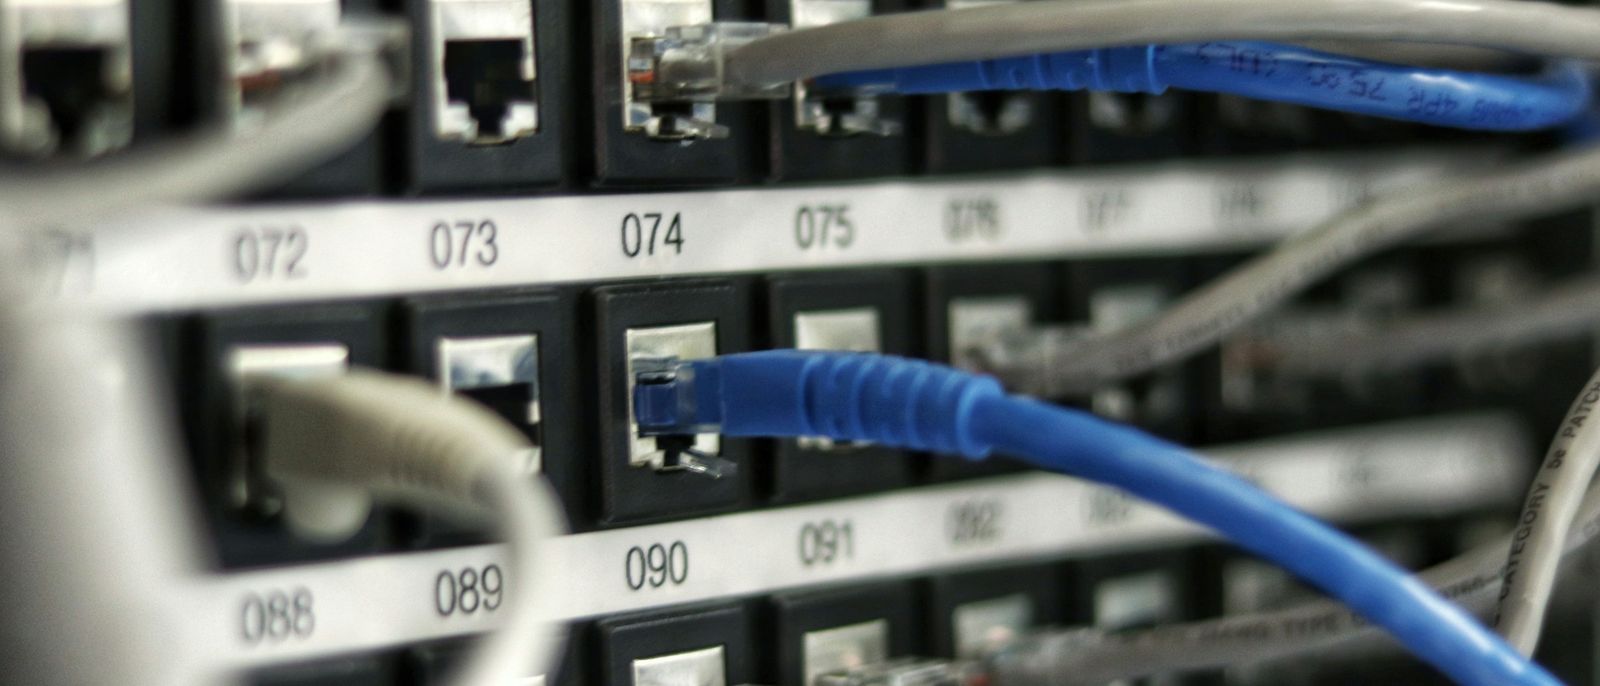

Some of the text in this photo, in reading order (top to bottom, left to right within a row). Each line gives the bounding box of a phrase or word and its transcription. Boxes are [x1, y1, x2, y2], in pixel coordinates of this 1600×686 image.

[232, 228, 309, 283] 072
[429, 219, 499, 269] 073
[620, 212, 685, 258] 074
[795, 205, 854, 250] 075
[240, 587, 315, 642] 088
[435, 563, 503, 617] 089
[624, 540, 689, 592] 090
[798, 520, 856, 566] 091
[1499, 483, 1550, 600] CATEGORY
